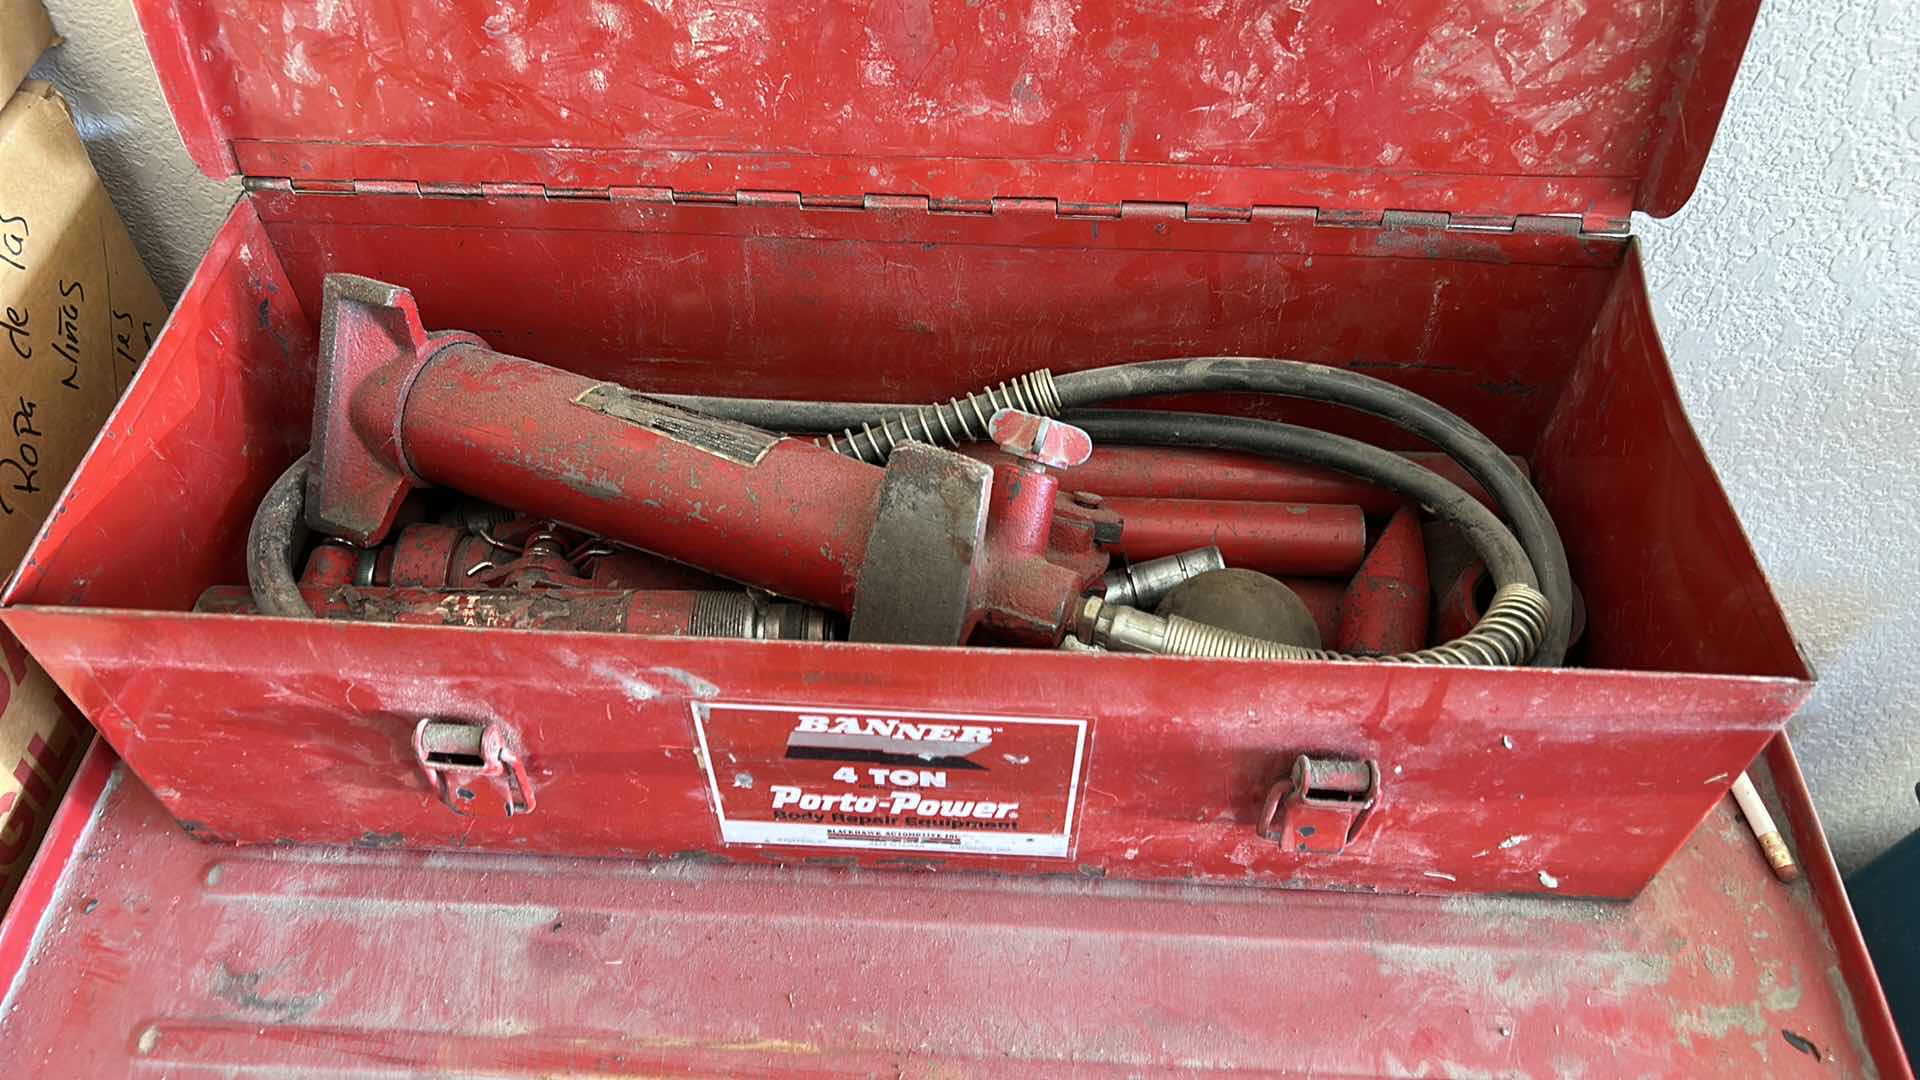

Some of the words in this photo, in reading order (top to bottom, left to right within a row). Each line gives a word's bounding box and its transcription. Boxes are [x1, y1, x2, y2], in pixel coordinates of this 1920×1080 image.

[0, 303, 33, 359] de
[832, 766, 859, 784] 4
[868, 767, 947, 788] TON
[773, 808, 825, 823] Body
[831, 811, 899, 827] Repair
[904, 814, 1019, 831] Equipment
